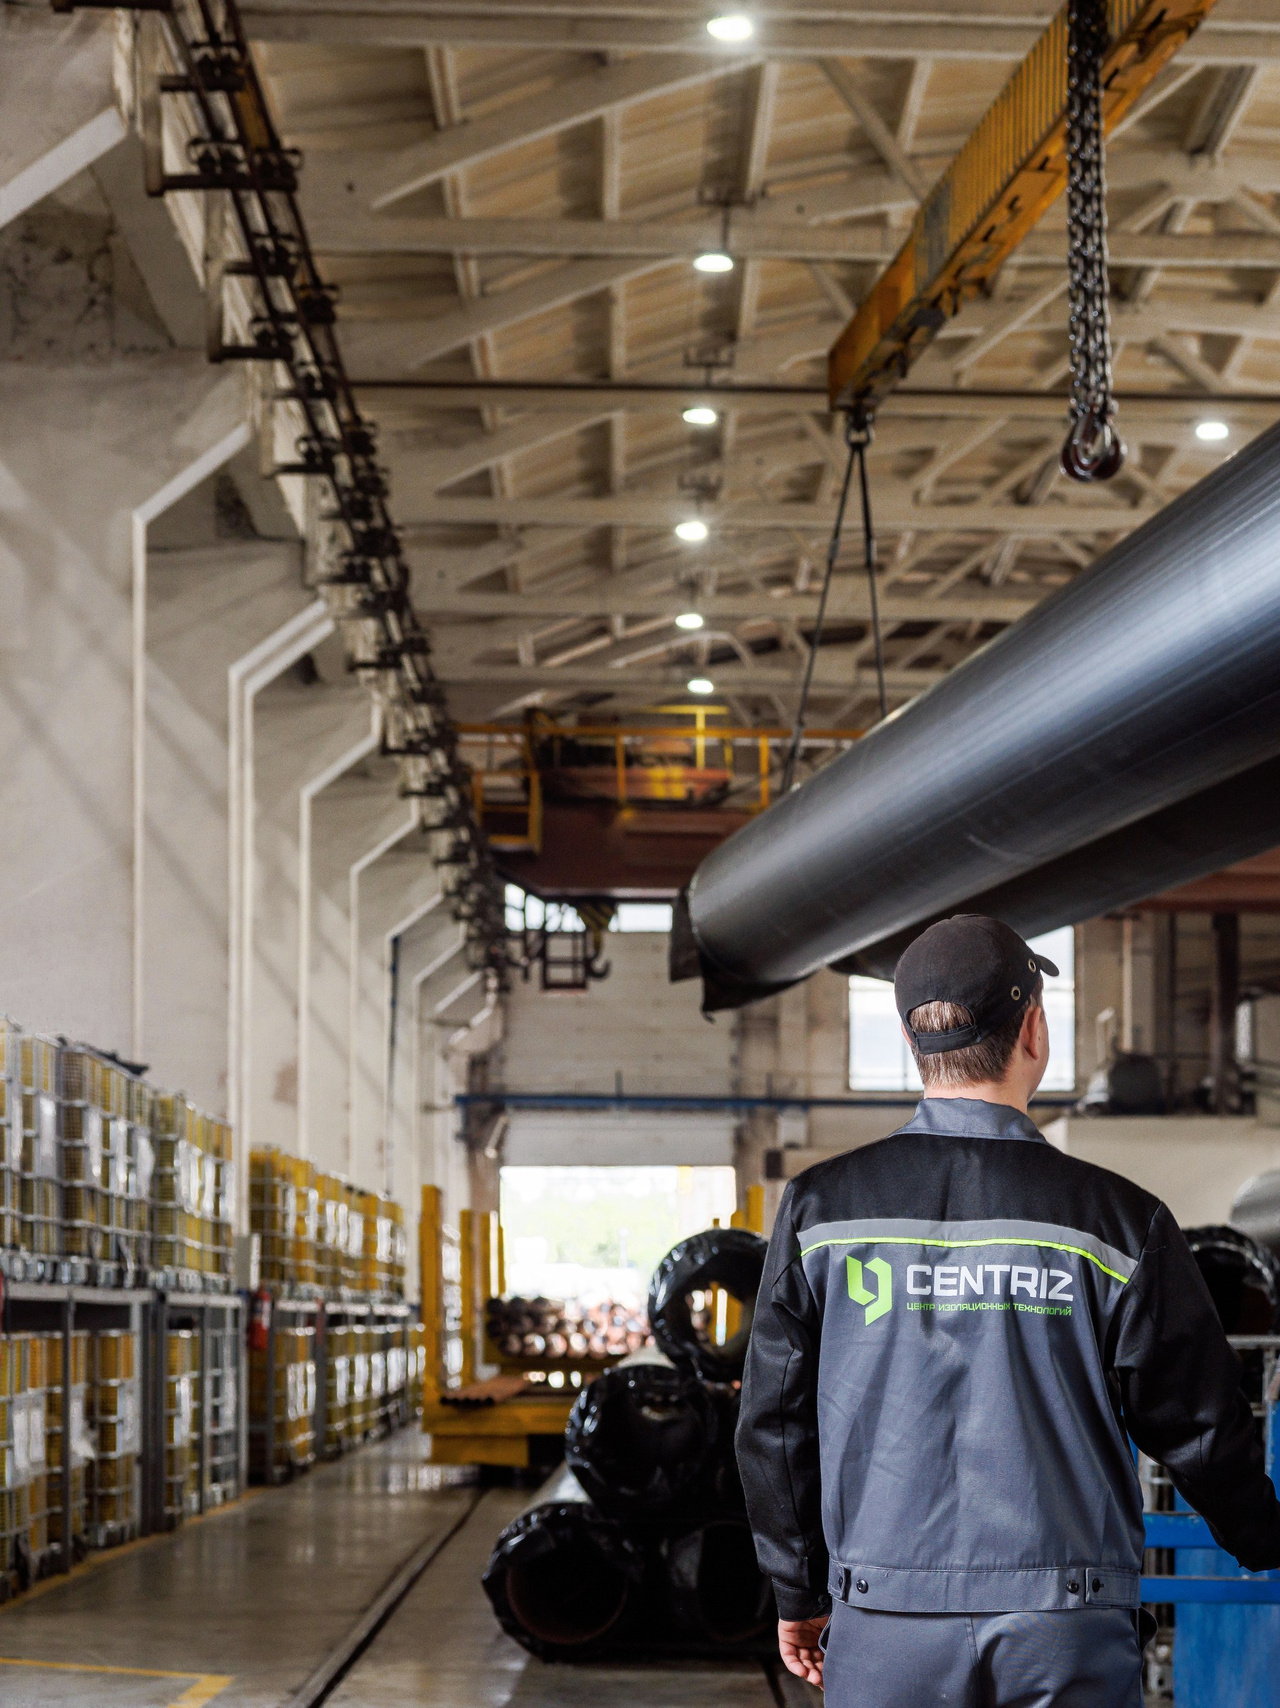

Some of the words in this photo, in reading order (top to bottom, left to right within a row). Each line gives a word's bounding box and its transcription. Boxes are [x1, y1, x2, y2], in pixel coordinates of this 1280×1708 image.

[906, 1264, 1074, 1302] CENTRIZ
[906, 1302, 936, 1312] ЦЕНТР
[938, 1302, 1011, 1312] ИЗОЛЯЦИОННЫХ
[1013, 1303, 1073, 1316] ТЕХНОЛОГИЙ
